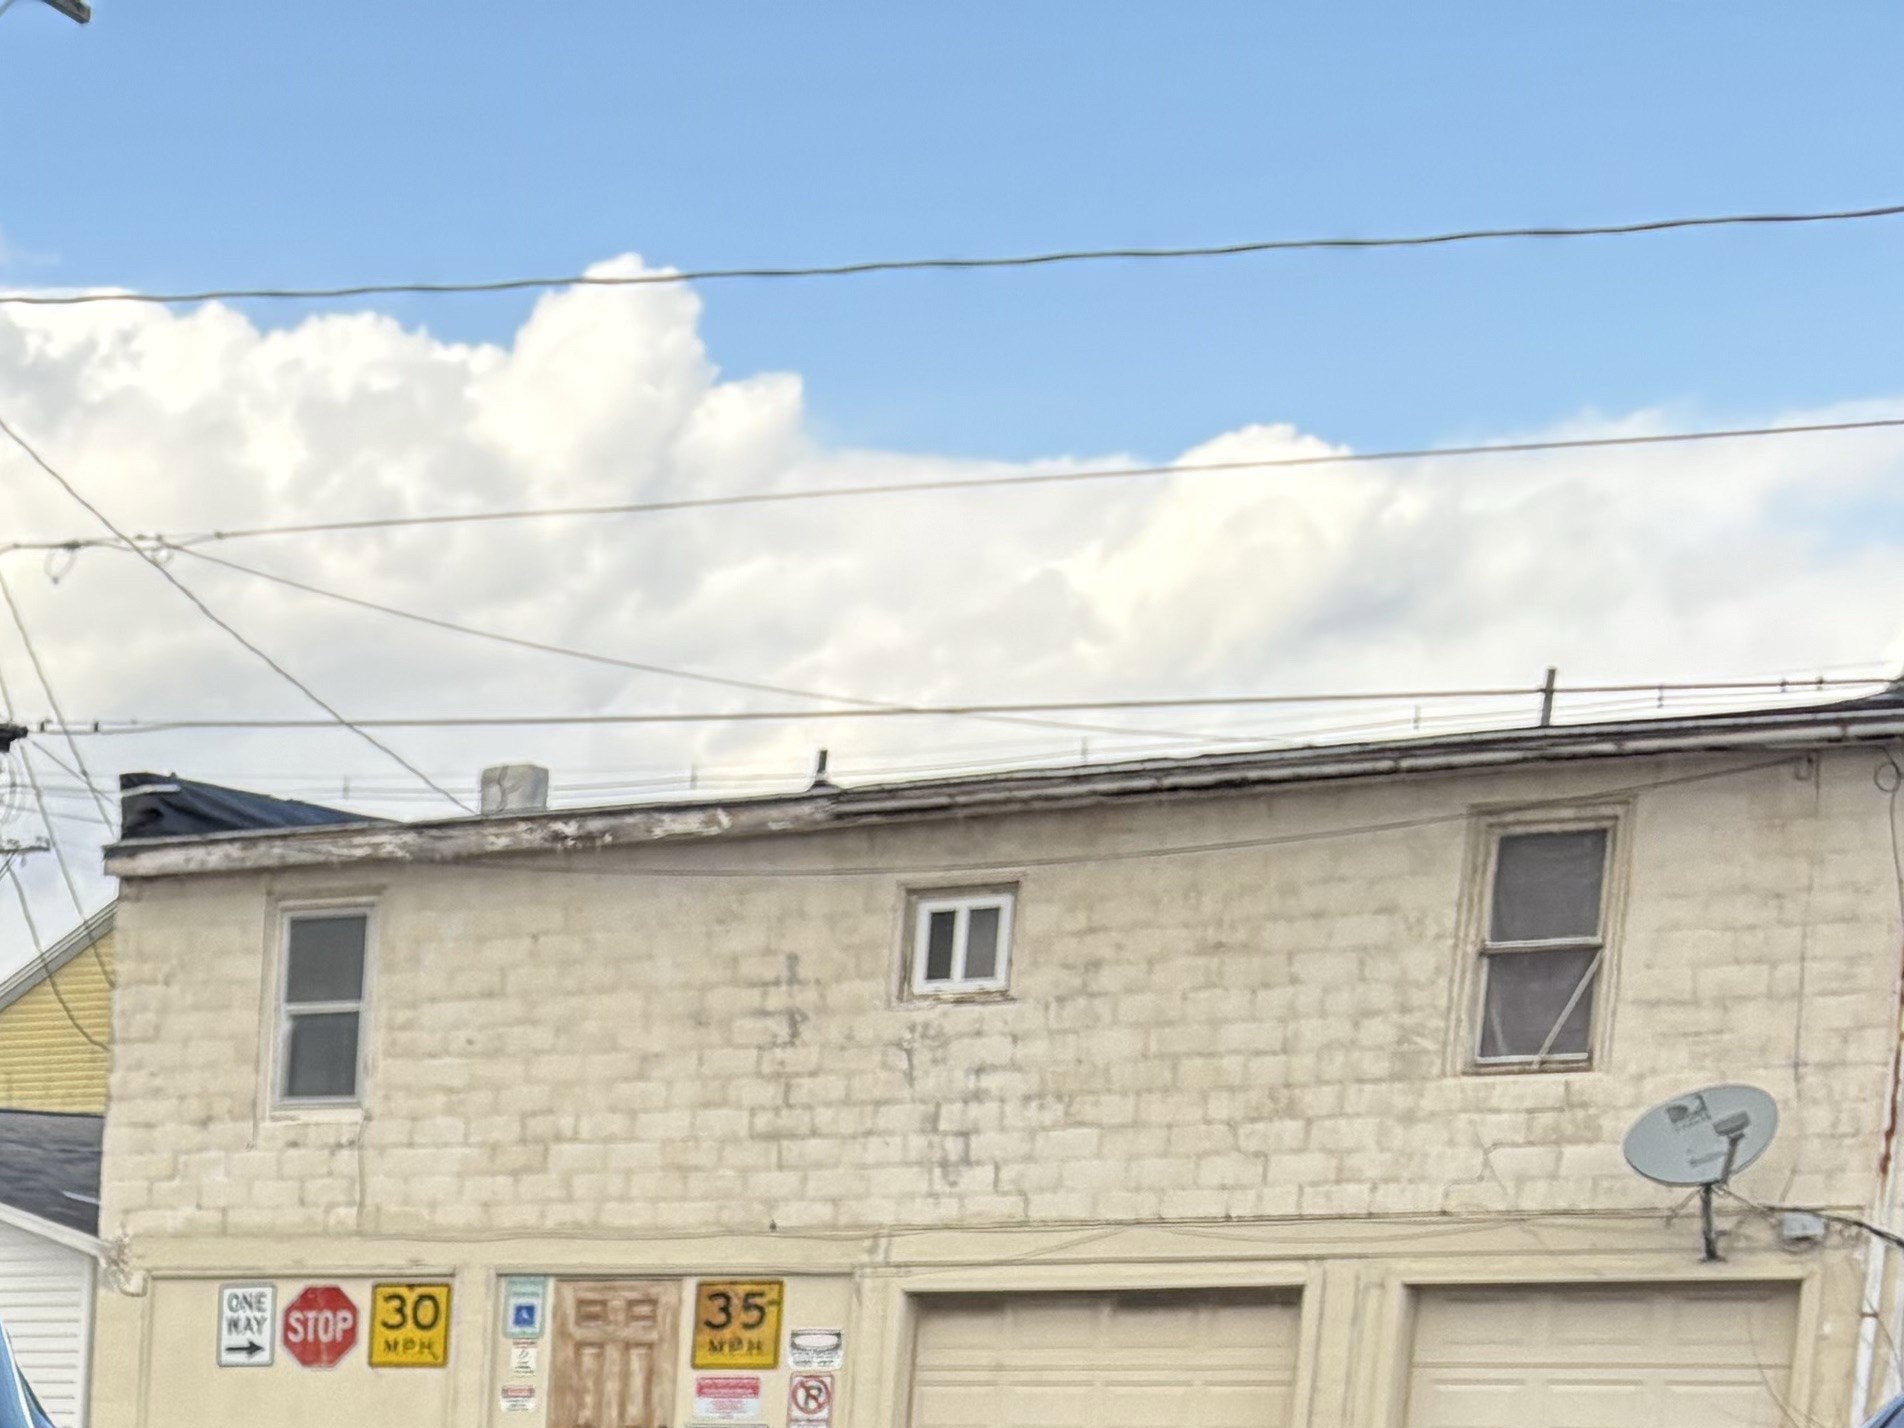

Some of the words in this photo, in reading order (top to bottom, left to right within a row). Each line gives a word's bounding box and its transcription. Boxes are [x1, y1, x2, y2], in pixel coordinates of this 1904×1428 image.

[226, 1291, 267, 1313] ONE
[381, 1294, 440, 1331] 30
[704, 1291, 766, 1330] 35
[226, 1315, 268, 1336] WAY
[288, 1309, 354, 1343] STOP
[383, 1338, 434, 1355] MPH
[708, 1336, 762, 1355] MPH
